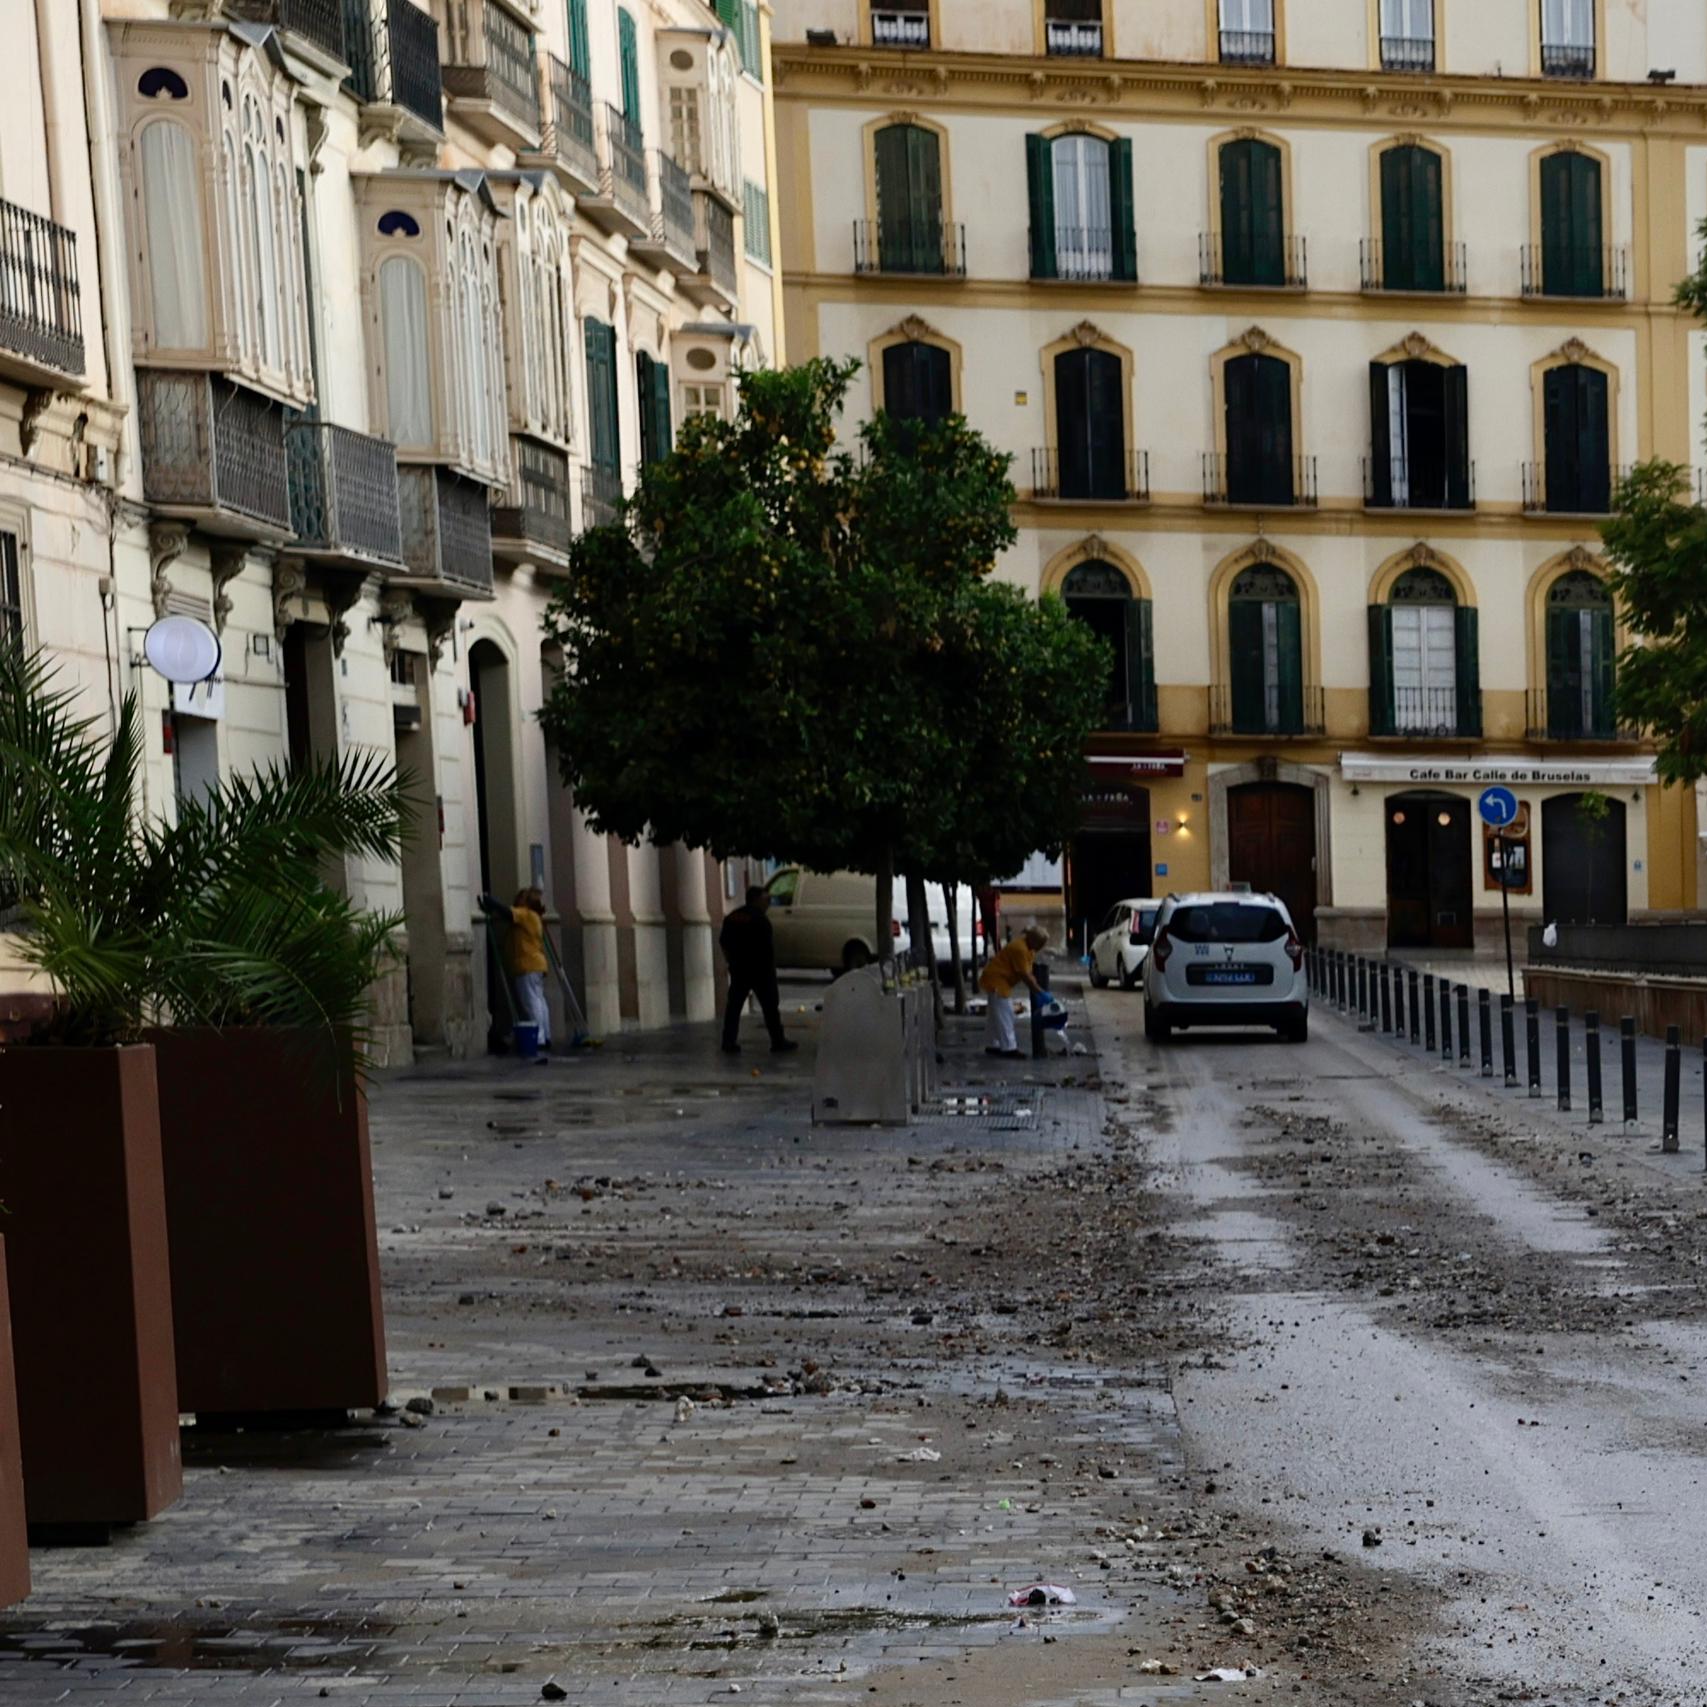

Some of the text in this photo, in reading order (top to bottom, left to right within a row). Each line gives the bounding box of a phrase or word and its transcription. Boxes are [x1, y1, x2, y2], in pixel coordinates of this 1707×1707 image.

[1409, 768, 1591, 782] Cafe Bar Calle de Bruselas
